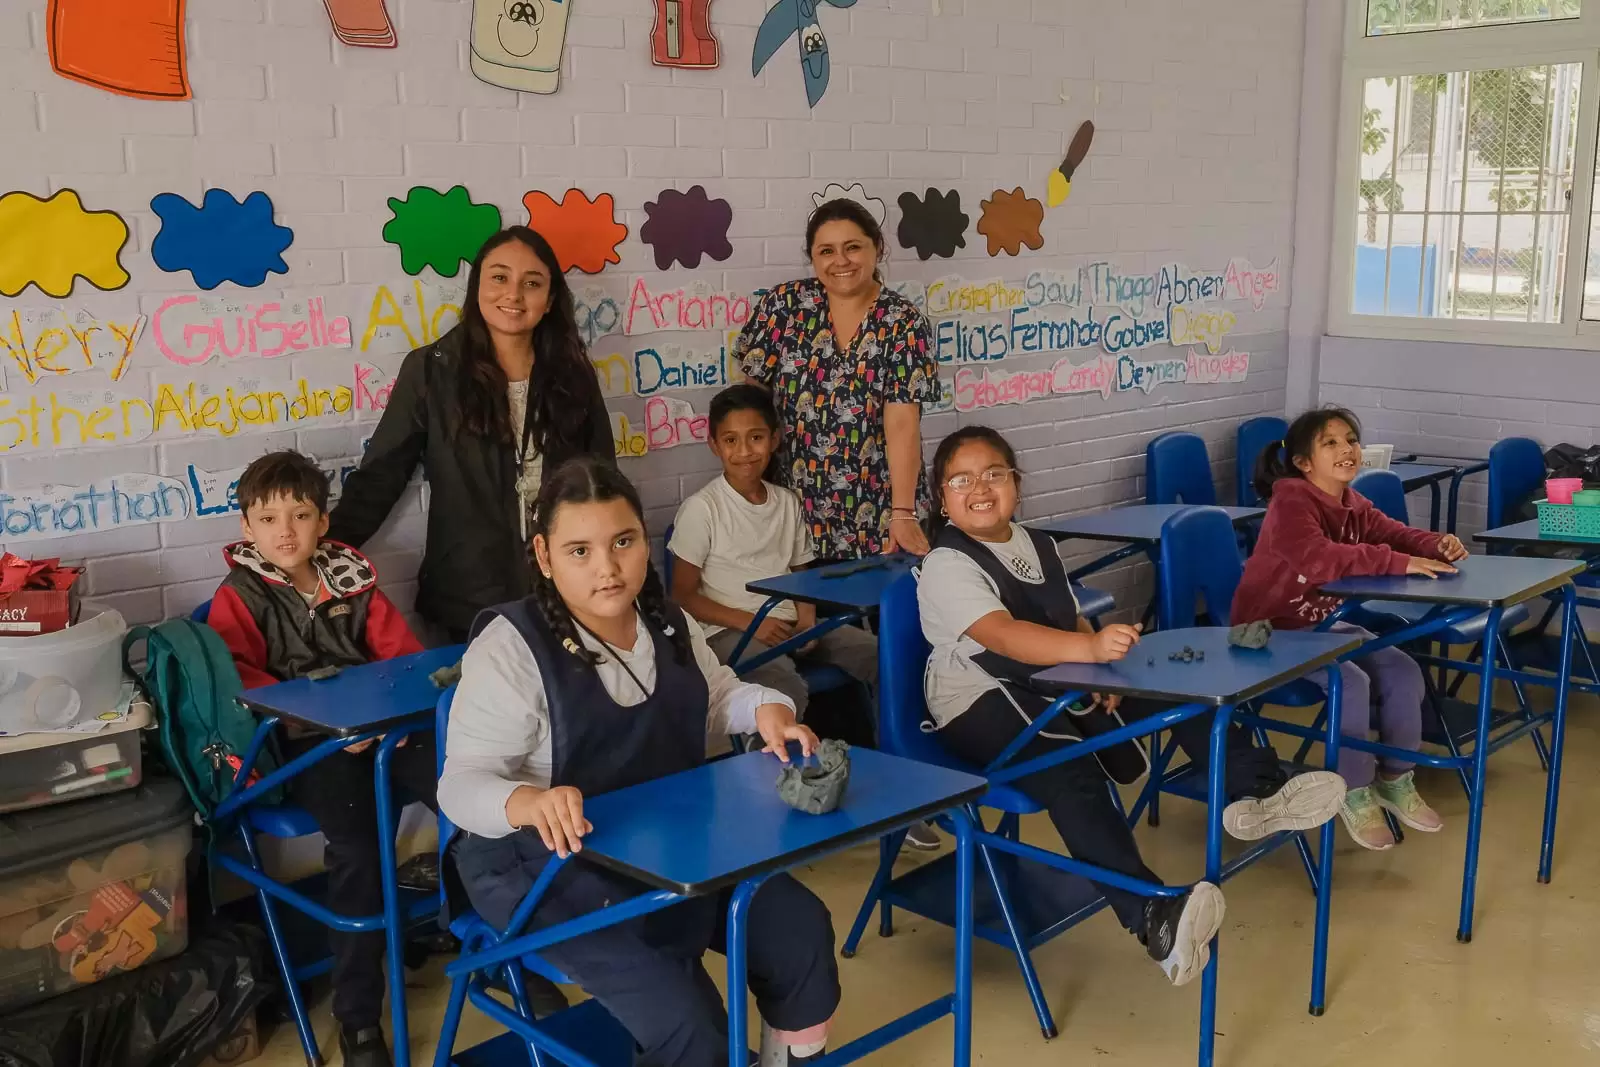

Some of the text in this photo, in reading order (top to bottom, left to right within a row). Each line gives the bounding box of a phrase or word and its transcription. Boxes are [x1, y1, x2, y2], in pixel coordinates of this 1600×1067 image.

[626, 277, 750, 334] Ariana
[936, 321, 1008, 362] Elias
[1104, 302, 1172, 352] Gabriel
[1171, 306, 1237, 353] Diego
[635, 346, 727, 394] Daniel
[1186, 350, 1249, 382] Angeles
[154, 378, 353, 437] Alejandro
[646, 397, 710, 449] Bre
[0, 606, 28, 621] ACY
